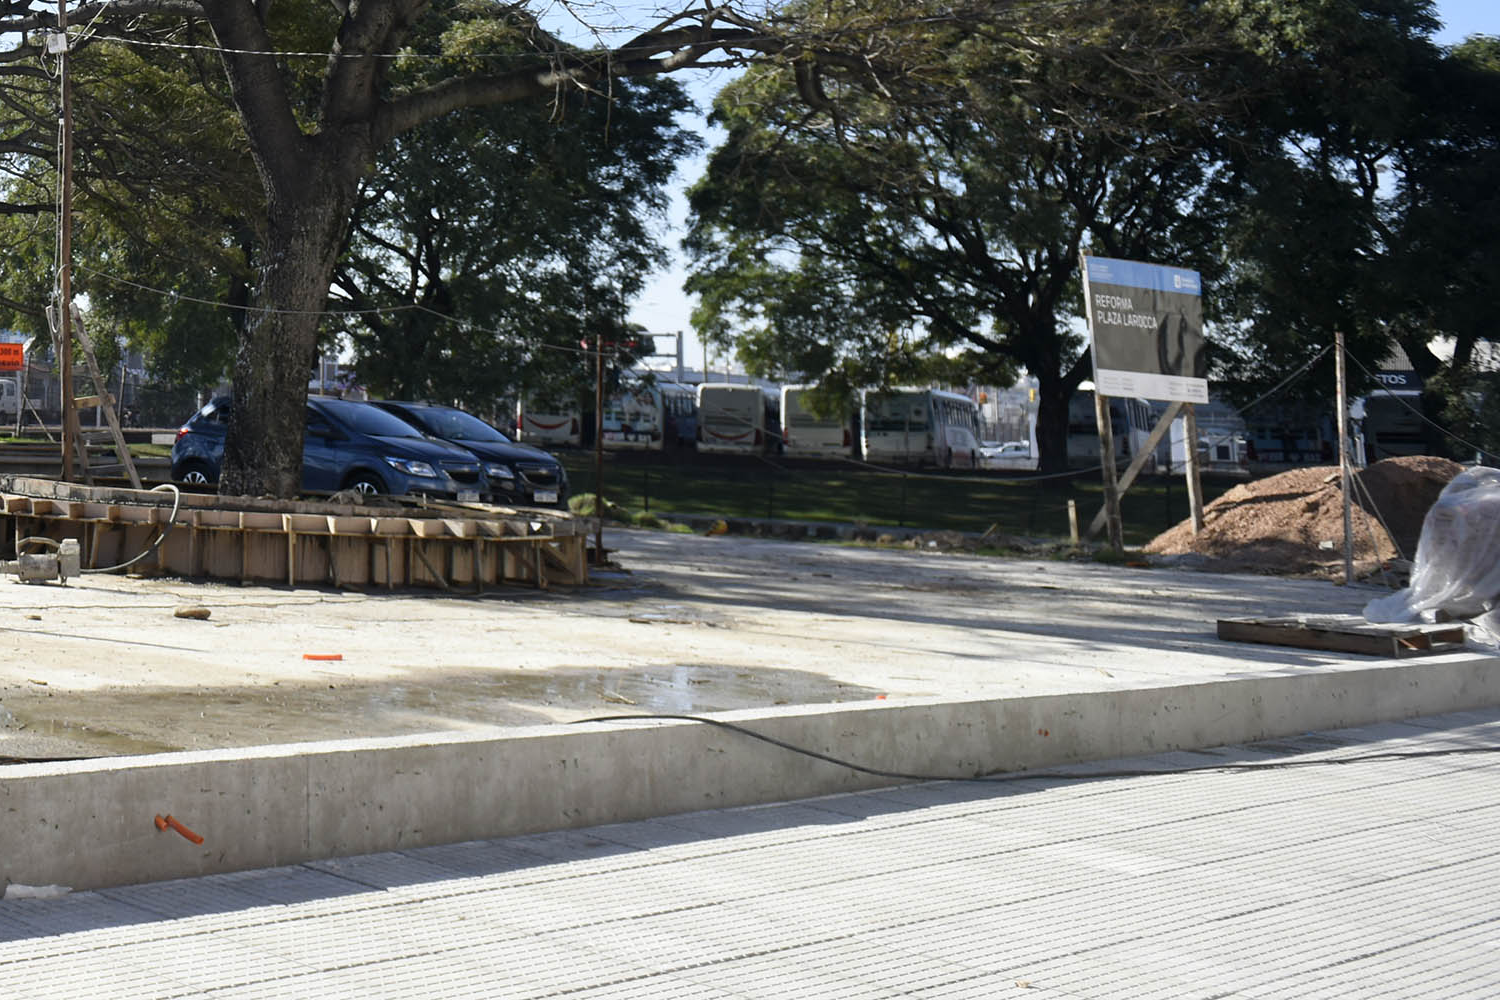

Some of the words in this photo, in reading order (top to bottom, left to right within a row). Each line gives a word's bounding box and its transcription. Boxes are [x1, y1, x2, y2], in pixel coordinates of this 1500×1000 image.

[1095, 294, 1134, 311] REFORMA
[1096, 310, 1122, 325] PLAZA
[1123, 313, 1158, 329] LAROCCA
